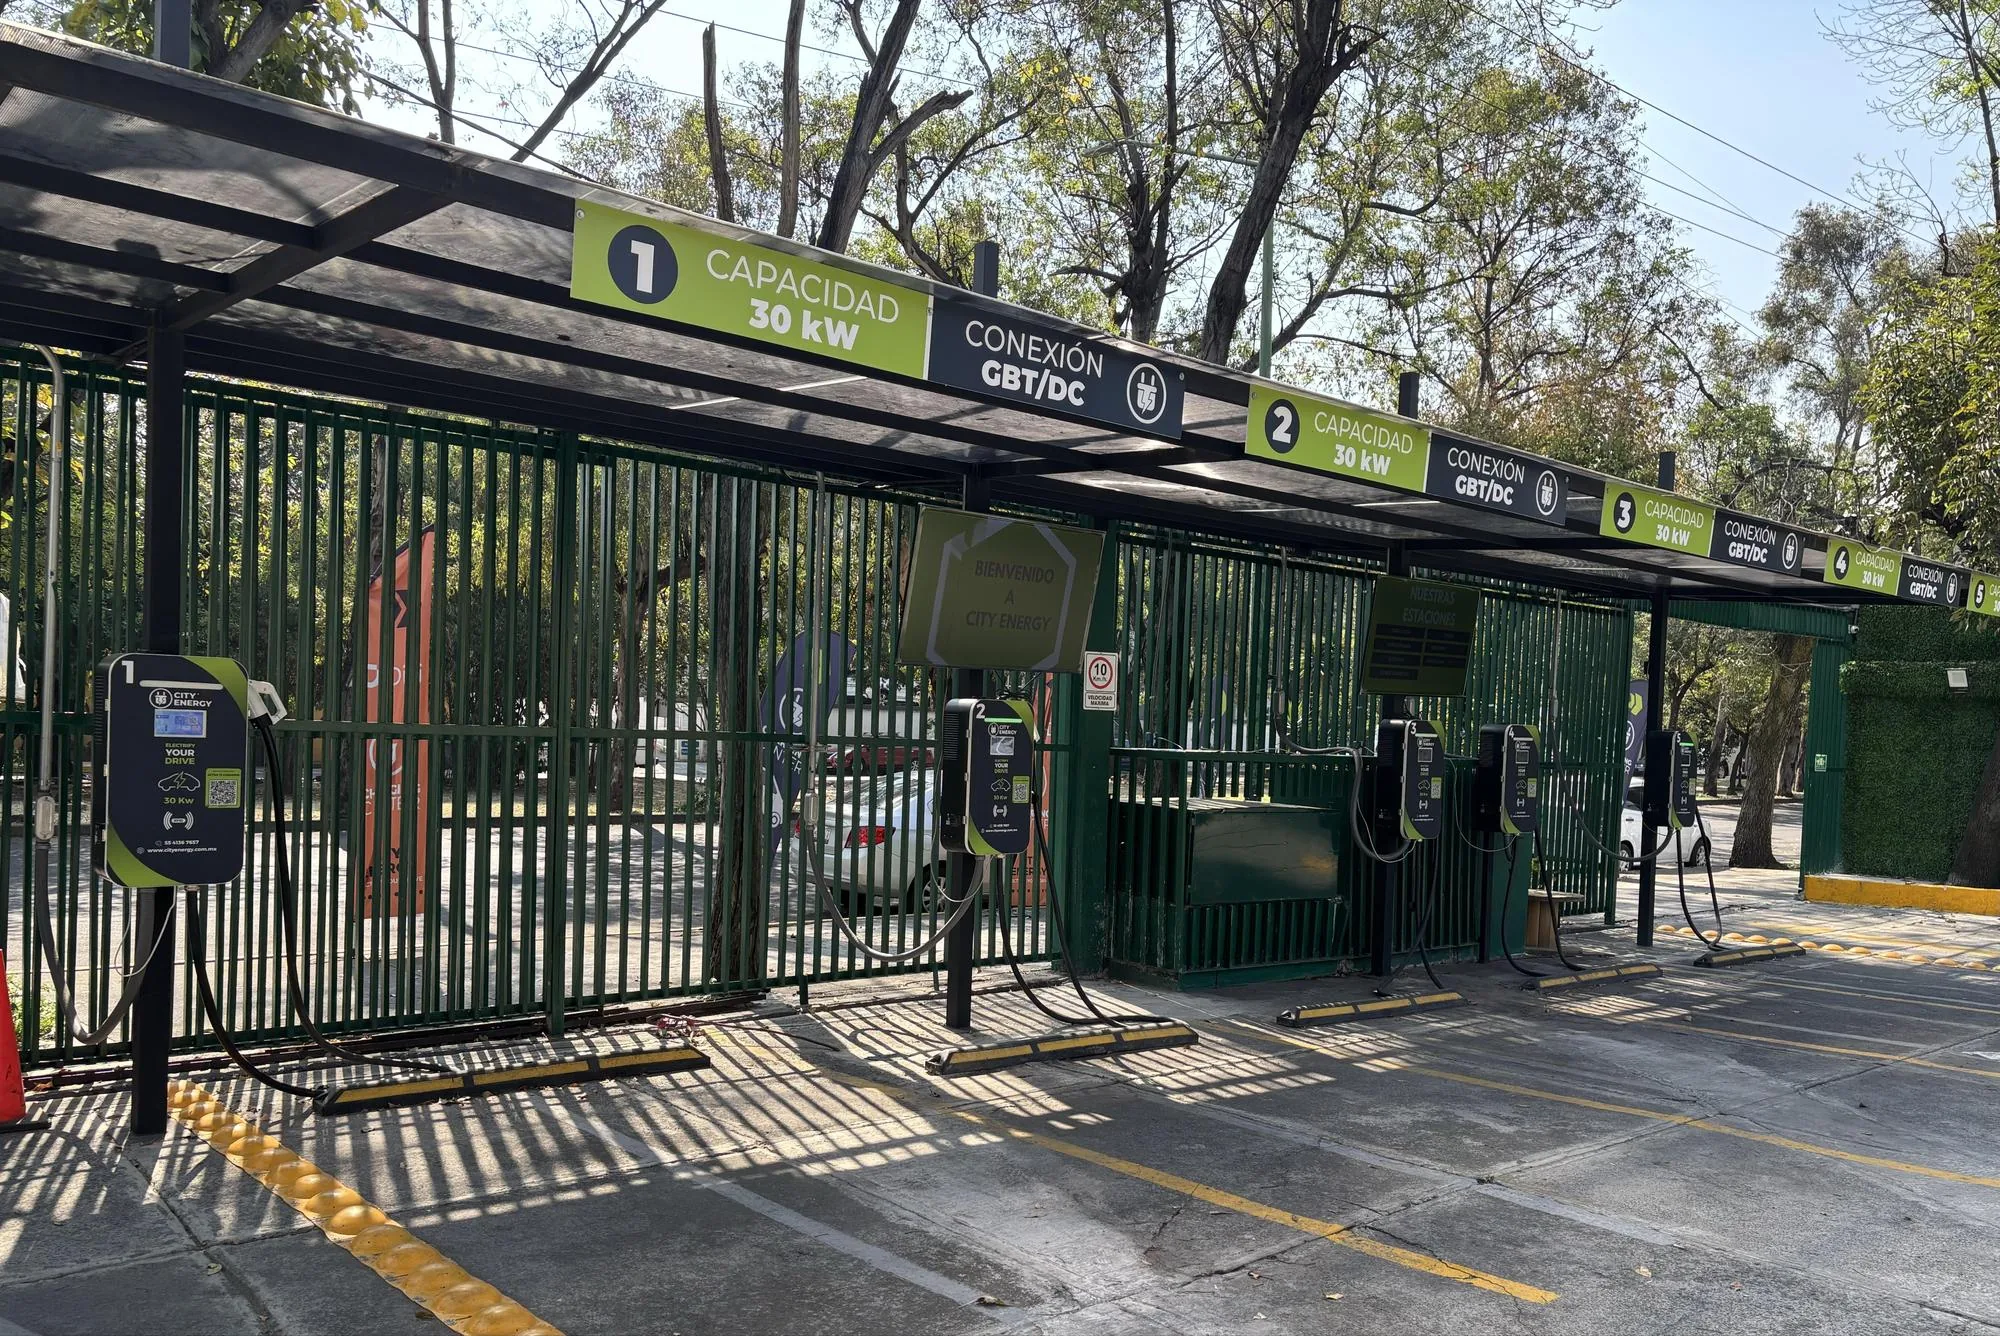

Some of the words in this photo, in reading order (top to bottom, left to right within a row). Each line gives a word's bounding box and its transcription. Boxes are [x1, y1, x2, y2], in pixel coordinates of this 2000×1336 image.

[629, 239, 656, 294] 1
[706, 249, 900, 324] CAPACIDAD
[748, 298, 793, 335] 30
[802, 313, 860, 351] kW
[965, 320, 1104, 379] CONEXIÓN
[980, 360, 1086, 408] GBT/DC
[1272, 406, 1293, 445] 2
[1314, 411, 1414, 455] CAPACIDAD
[1333, 443, 1357, 467] 30
[1360, 449, 1392, 477] kW
[1447, 447, 1526, 485] CONEXIÓN
[1455, 474, 1514, 506] GBT/DC
[1617, 500, 1632, 529] 3
[1644, 500, 1705, 529] CAPACIDAD
[1655, 524, 1670, 542] 30
[1672, 528, 1691, 547] kW
[1724, 520, 1777, 546] CONEXIÓN
[1728, 541, 1768, 564] GBT/DC
[1836, 551, 1847, 574] 4
[1855, 552, 1895, 573] CAPACIDAD
[975, 560, 1055, 583] BIENVENIDO
[1862, 571, 1871, 585] 30
[1872, 573, 1885, 588] kW
[1907, 564, 1944, 585] CONEXIÓN
[1004, 589, 1015, 605] A
[1409, 586, 1456, 605] NUESTRAS
[1910, 581, 1938, 600] GBT/DC
[1976, 584, 1984, 604] 5
[966, 610, 995, 627] CITY
[999, 614, 1053, 631] ENERGY
[121, 660, 135, 684] 1
[1094, 663, 1107, 676] 10
[173, 699, 212, 707] ENERGY
[976, 703, 986, 719] 2
[1410, 722, 1417, 735] 3
[1508, 727, 1515, 739] 4
[165, 749, 195, 757] YOUR
[165, 757, 195, 765] DRIVE
